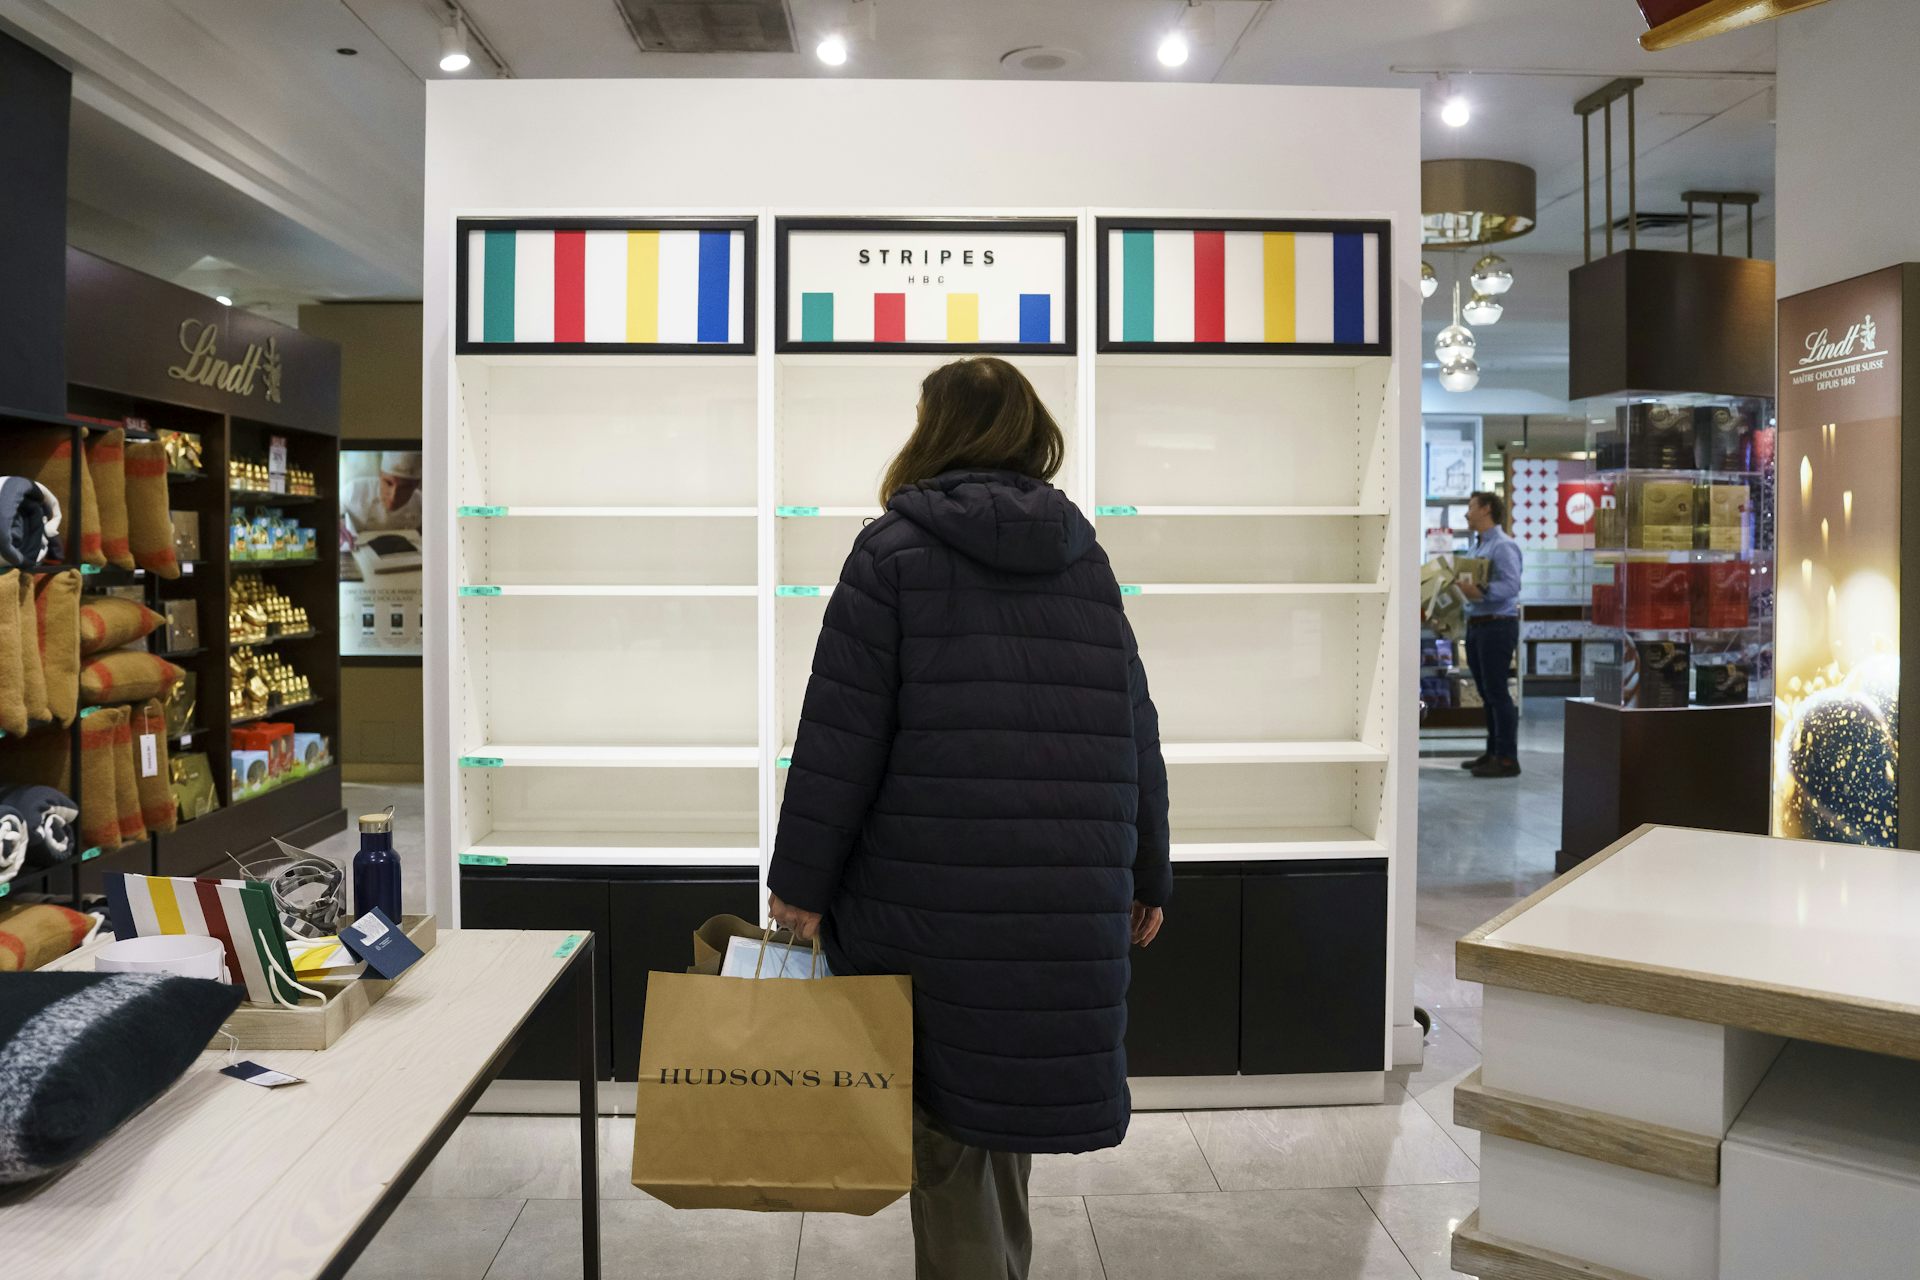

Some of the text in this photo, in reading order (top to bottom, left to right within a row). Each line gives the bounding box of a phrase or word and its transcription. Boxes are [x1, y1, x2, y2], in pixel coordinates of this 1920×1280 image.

[858, 249, 996, 265] STRIPES
[1798, 323, 1861, 366] Lindt
[168, 318, 263, 397] Lindt
[1815, 363, 1861, 380] CHOCOLATIER
[1861, 359, 1884, 372] SUISSE
[1816, 376, 1856, 392] DEPUIS 1845
[126, 417, 147, 432] SALE
[660, 1068, 896, 1089] HUDSON'S BAY
